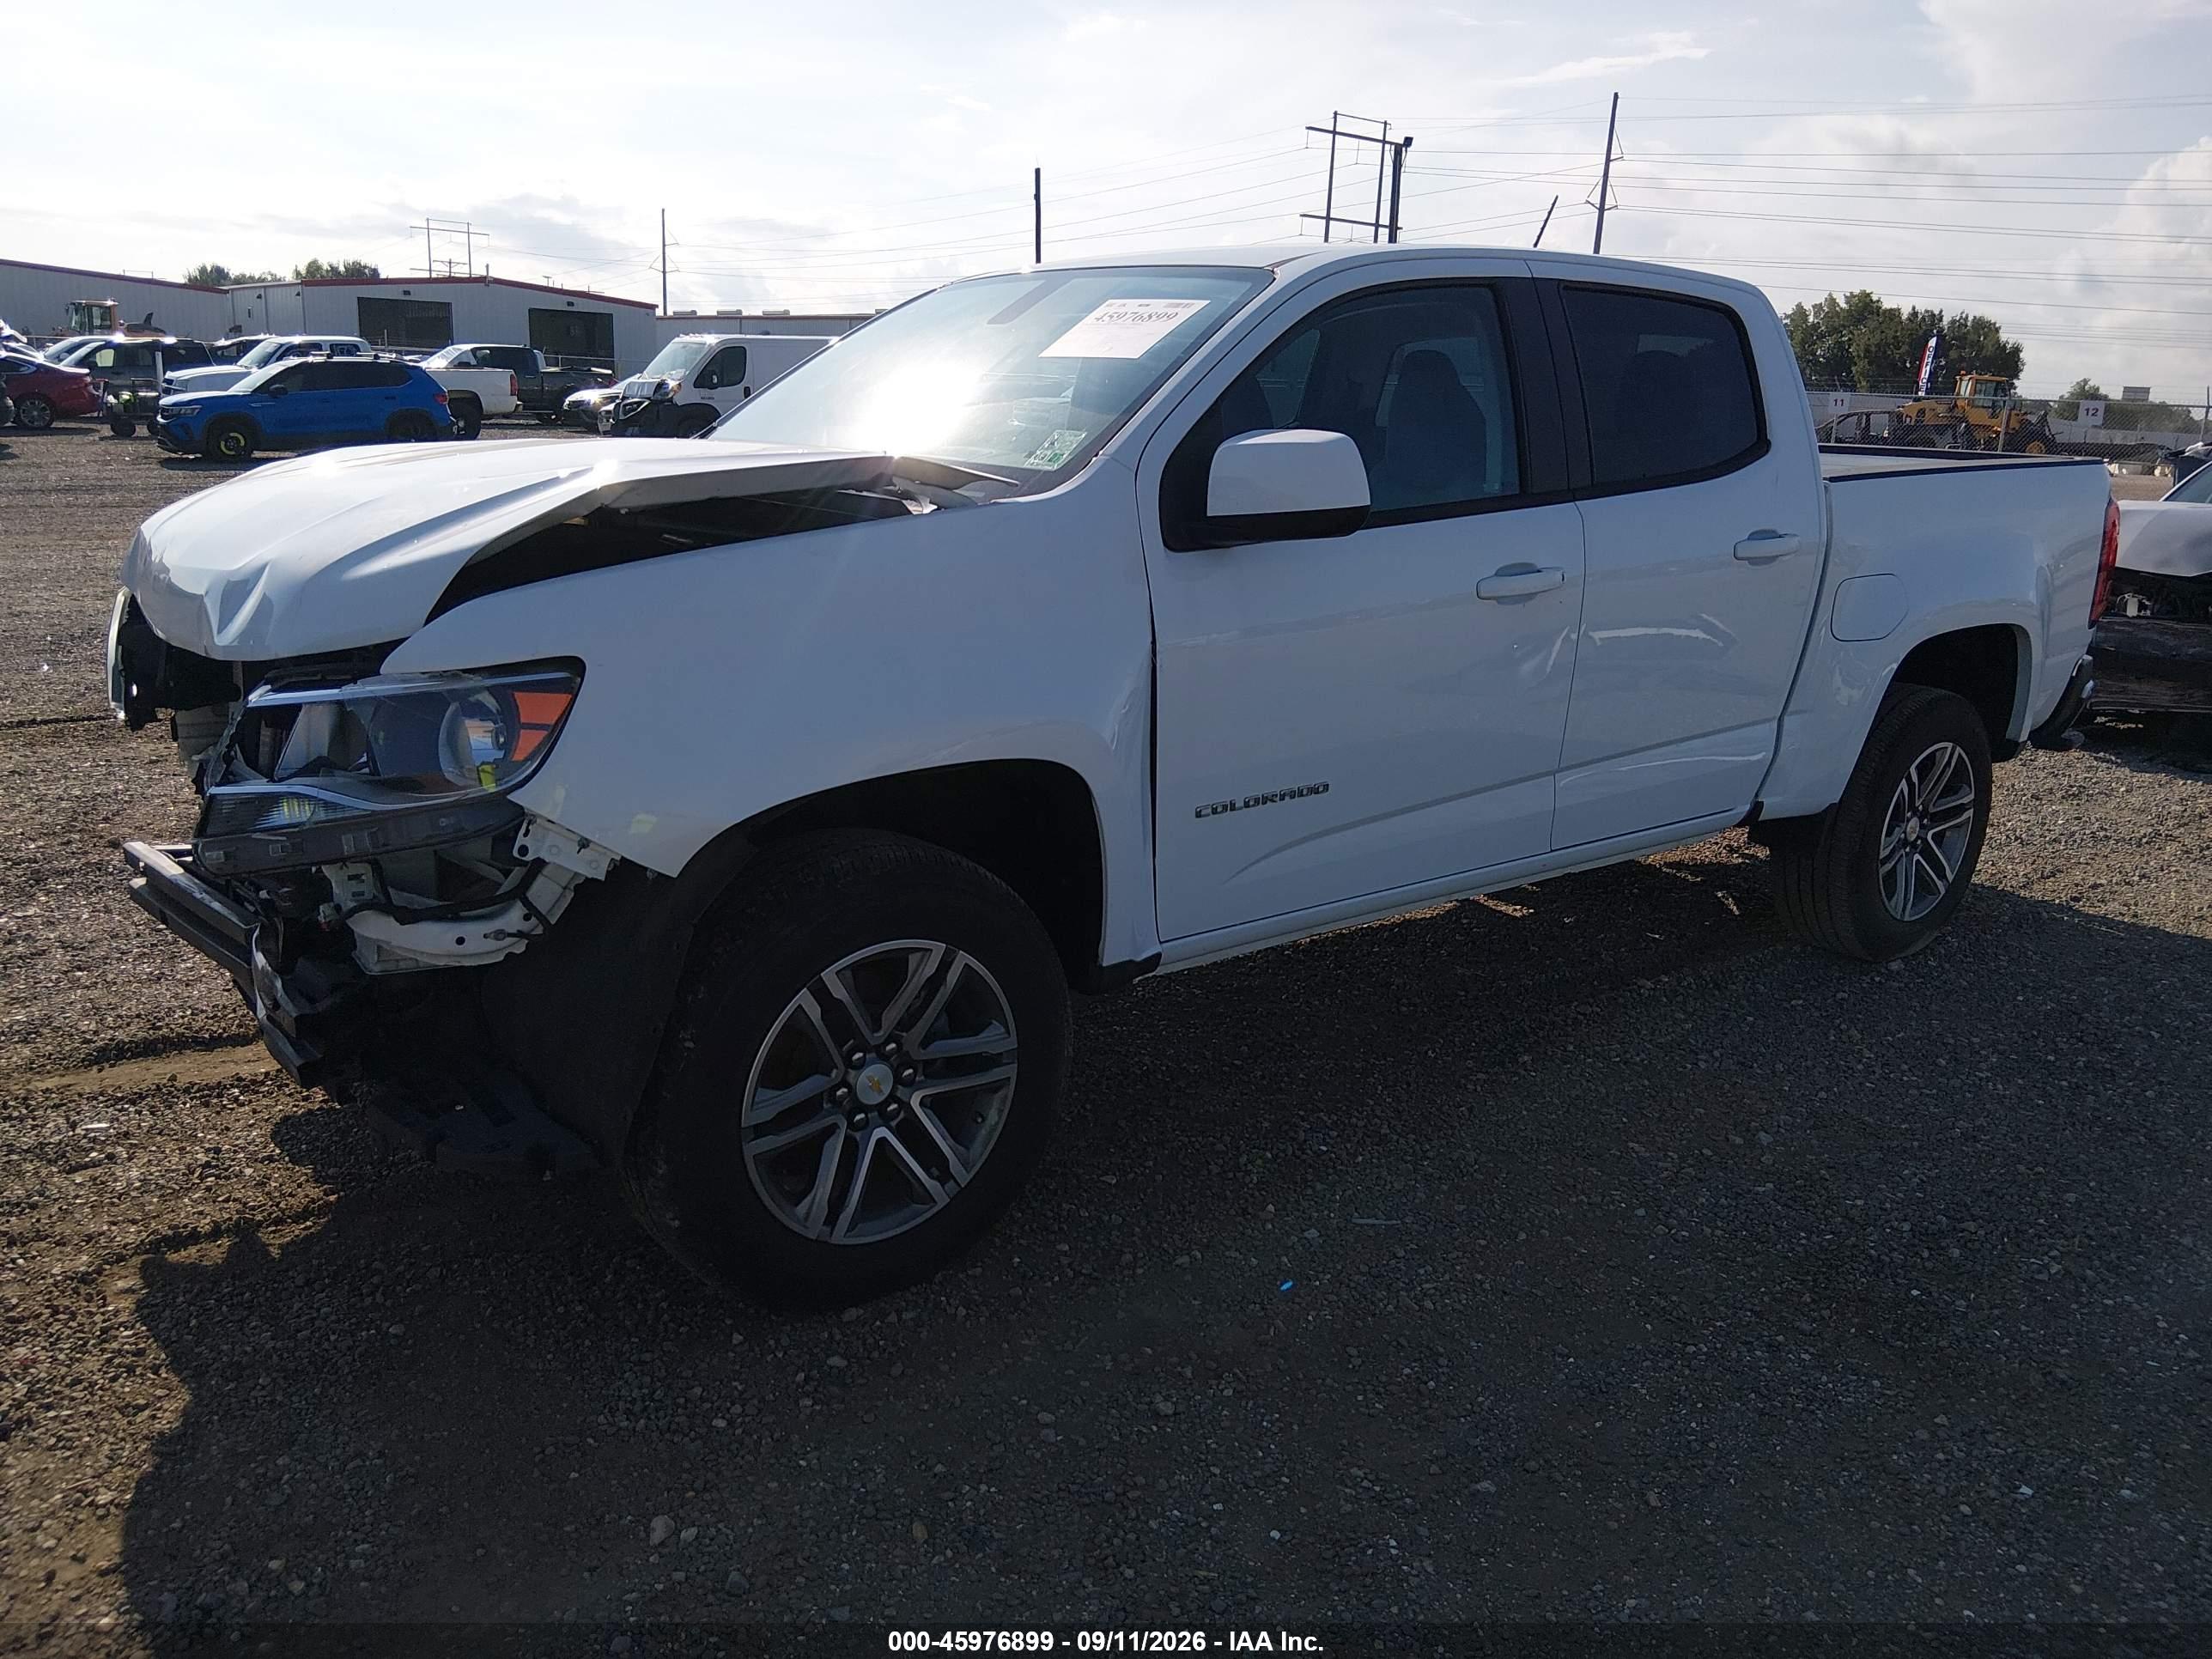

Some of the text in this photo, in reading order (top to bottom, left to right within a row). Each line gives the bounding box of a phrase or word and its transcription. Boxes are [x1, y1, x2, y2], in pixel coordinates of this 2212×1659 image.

[1094, 311, 1178, 323] 45976899
[1919, 345, 1935, 392] OFFICE
[1833, 398, 1844, 407] 11
[2085, 407, 2100, 417] 12
[1194, 781, 1330, 819] COLORADO
